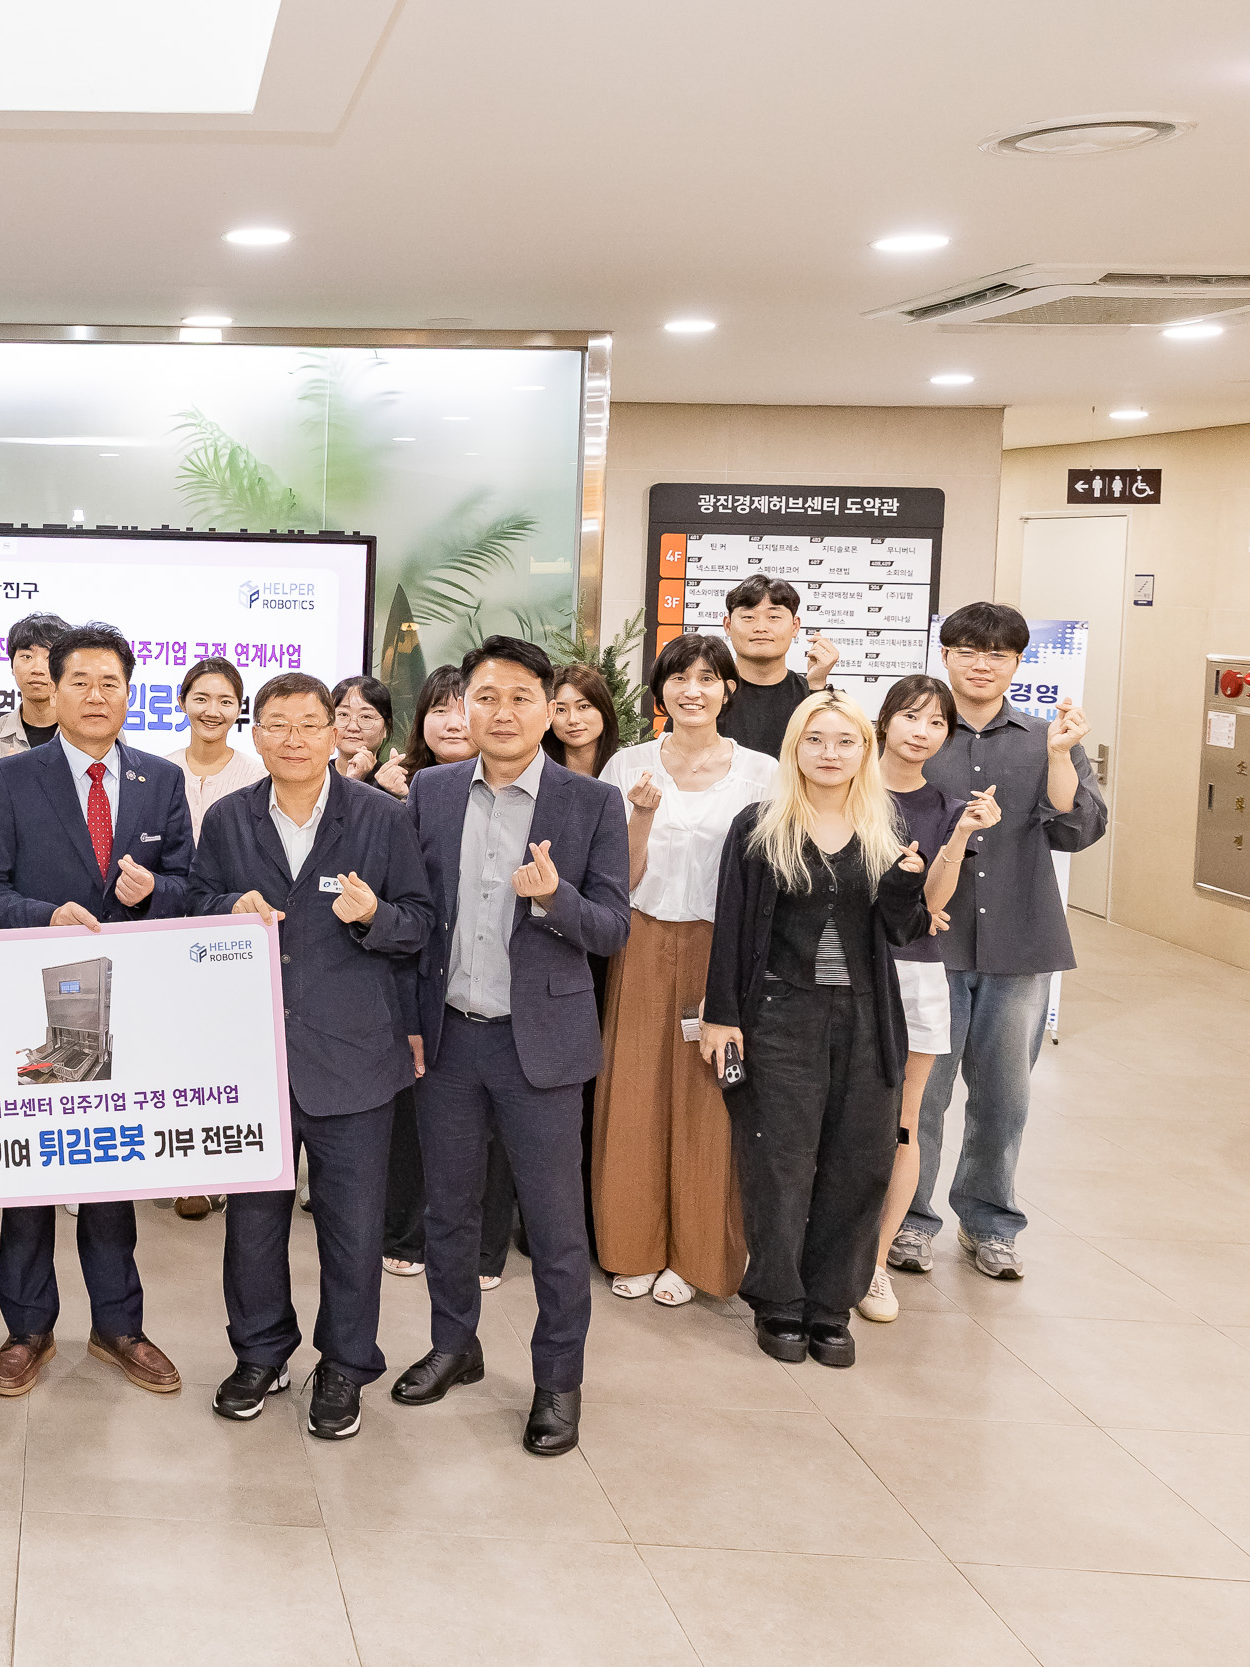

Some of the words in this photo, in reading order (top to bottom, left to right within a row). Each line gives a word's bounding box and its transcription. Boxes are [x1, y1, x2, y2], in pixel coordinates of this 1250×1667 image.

[697, 494, 840, 516] 광진경제허브센터
[844, 497, 900, 517] 도약관
[665, 549, 682, 562] 4F
[262, 582, 315, 596] HELPER
[262, 599, 315, 610] ROBOTICS
[663, 595, 680, 608] 3F
[234, 642, 301, 669] 연계사업
[1009, 682, 1059, 704] 경영
[209, 939, 253, 952] HELPER
[209, 951, 253, 963] ROBOTICS
[59, 1092, 127, 1115] 입주기업
[133, 1089, 166, 1110] 구정
[172, 1084, 239, 1107] 연계사업
[38, 1123, 146, 1168] 튀김로봇
[154, 1127, 196, 1159] 기부
[201, 1122, 264, 1157] 전달식
